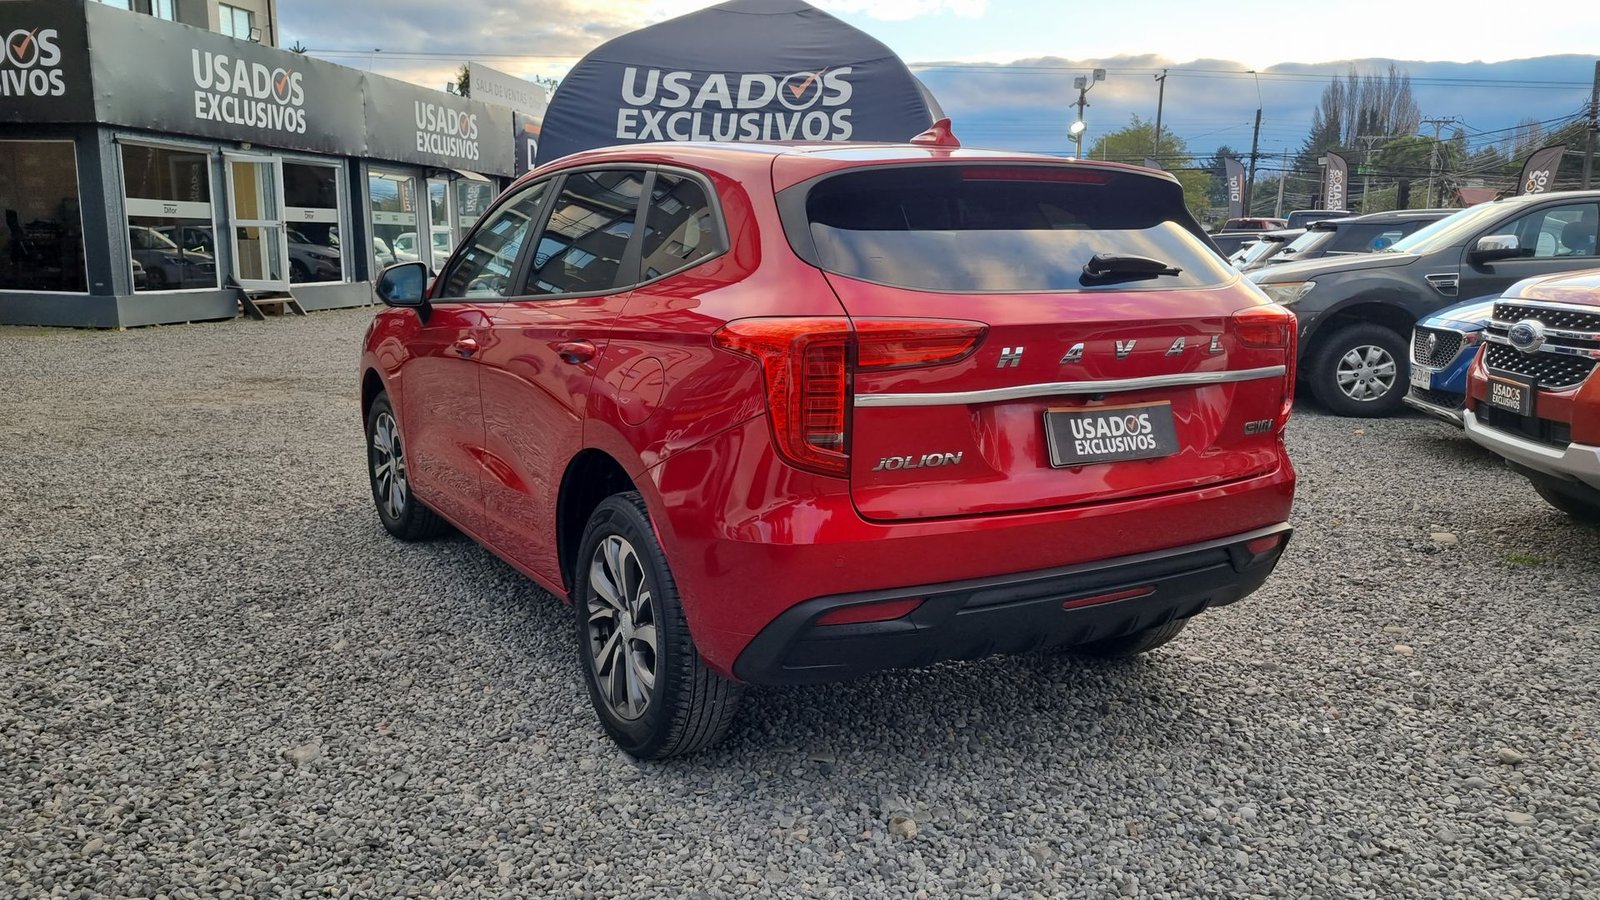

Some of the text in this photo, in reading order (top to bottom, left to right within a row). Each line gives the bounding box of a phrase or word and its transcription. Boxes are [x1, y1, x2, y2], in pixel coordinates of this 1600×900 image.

[0, 29, 61, 68] OS
[192, 49, 304, 106] USADOS
[476, 78, 493, 96] SALA
[494, 84, 503, 98] DE
[503, 87, 528, 105] VENTAS
[621, 66, 853, 110] USADOS
[194, 90, 306, 134] EXCLUSIVOS
[415, 101, 478, 139] USADOS
[616, 108, 853, 142] EXCLUSIVOS
[416, 131, 480, 160] EXCLUSIVOS
[1524, 170, 1541, 195] OS
[164, 207, 178, 215] Difor
[997, 333, 1225, 368] HAVAL
[1492, 394, 1520, 410] EXCLUSIVOS
[1493, 383, 1520, 401] USADOS
[1070, 413, 1152, 439] USADOS
[1074, 434, 1156, 455] EXCLUSIVOS
[872, 452, 963, 471] JOLION
